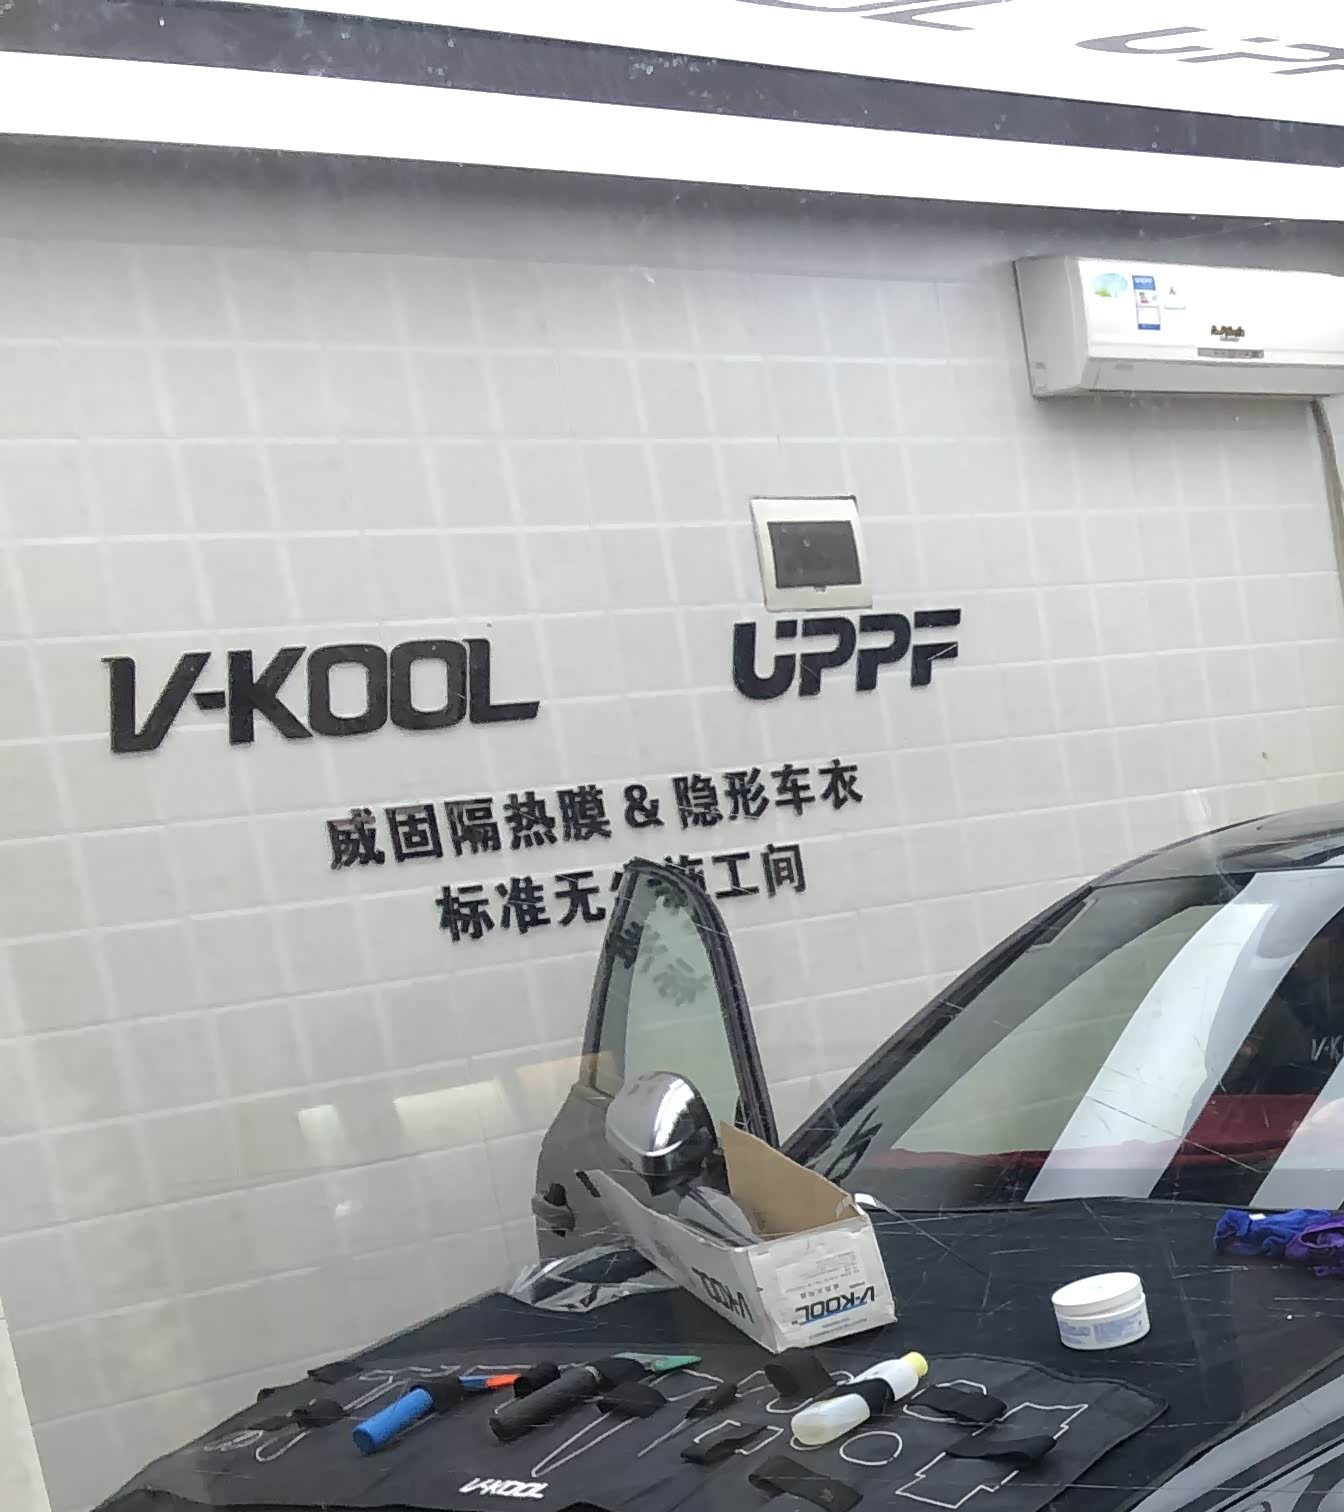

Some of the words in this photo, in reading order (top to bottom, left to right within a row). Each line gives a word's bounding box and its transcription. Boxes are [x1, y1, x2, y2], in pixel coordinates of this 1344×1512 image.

[101, 637, 540, 755] V-KOOL
[732, 607, 962, 702] UPPF
[325, 783, 613, 870] 威固隔热膜
[622, 784, 665, 829] &
[672, 758, 864, 831] 隐形车衣
[795, 1285, 875, 1326] V-KOOL
[458, 1477, 549, 1499] V-KOOL
